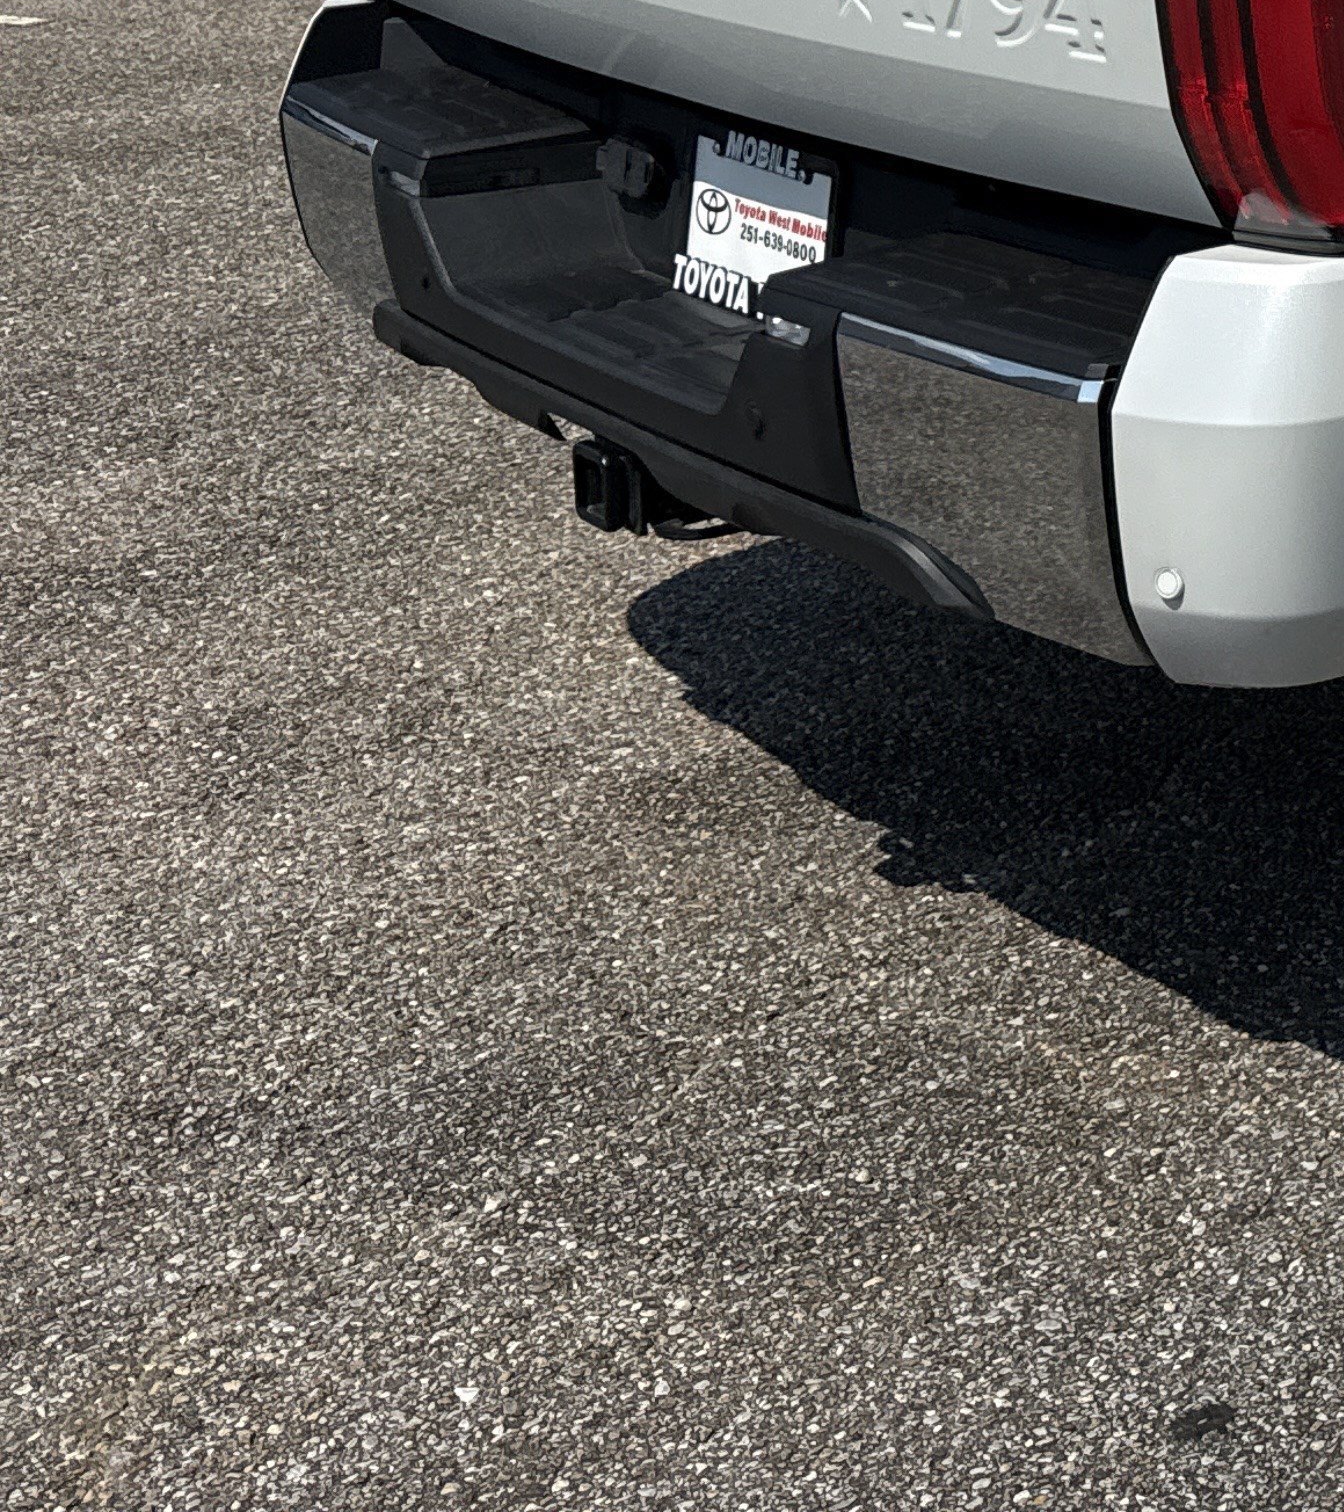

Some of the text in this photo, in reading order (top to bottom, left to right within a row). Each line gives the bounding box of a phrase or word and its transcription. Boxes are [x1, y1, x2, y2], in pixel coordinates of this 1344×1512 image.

[725, 129, 801, 179] MOBILE
[735, 198, 828, 242] Toyota West Mobile
[740, 223, 817, 265] 251-639-0800
[672, 253, 749, 314] TOYOTA
